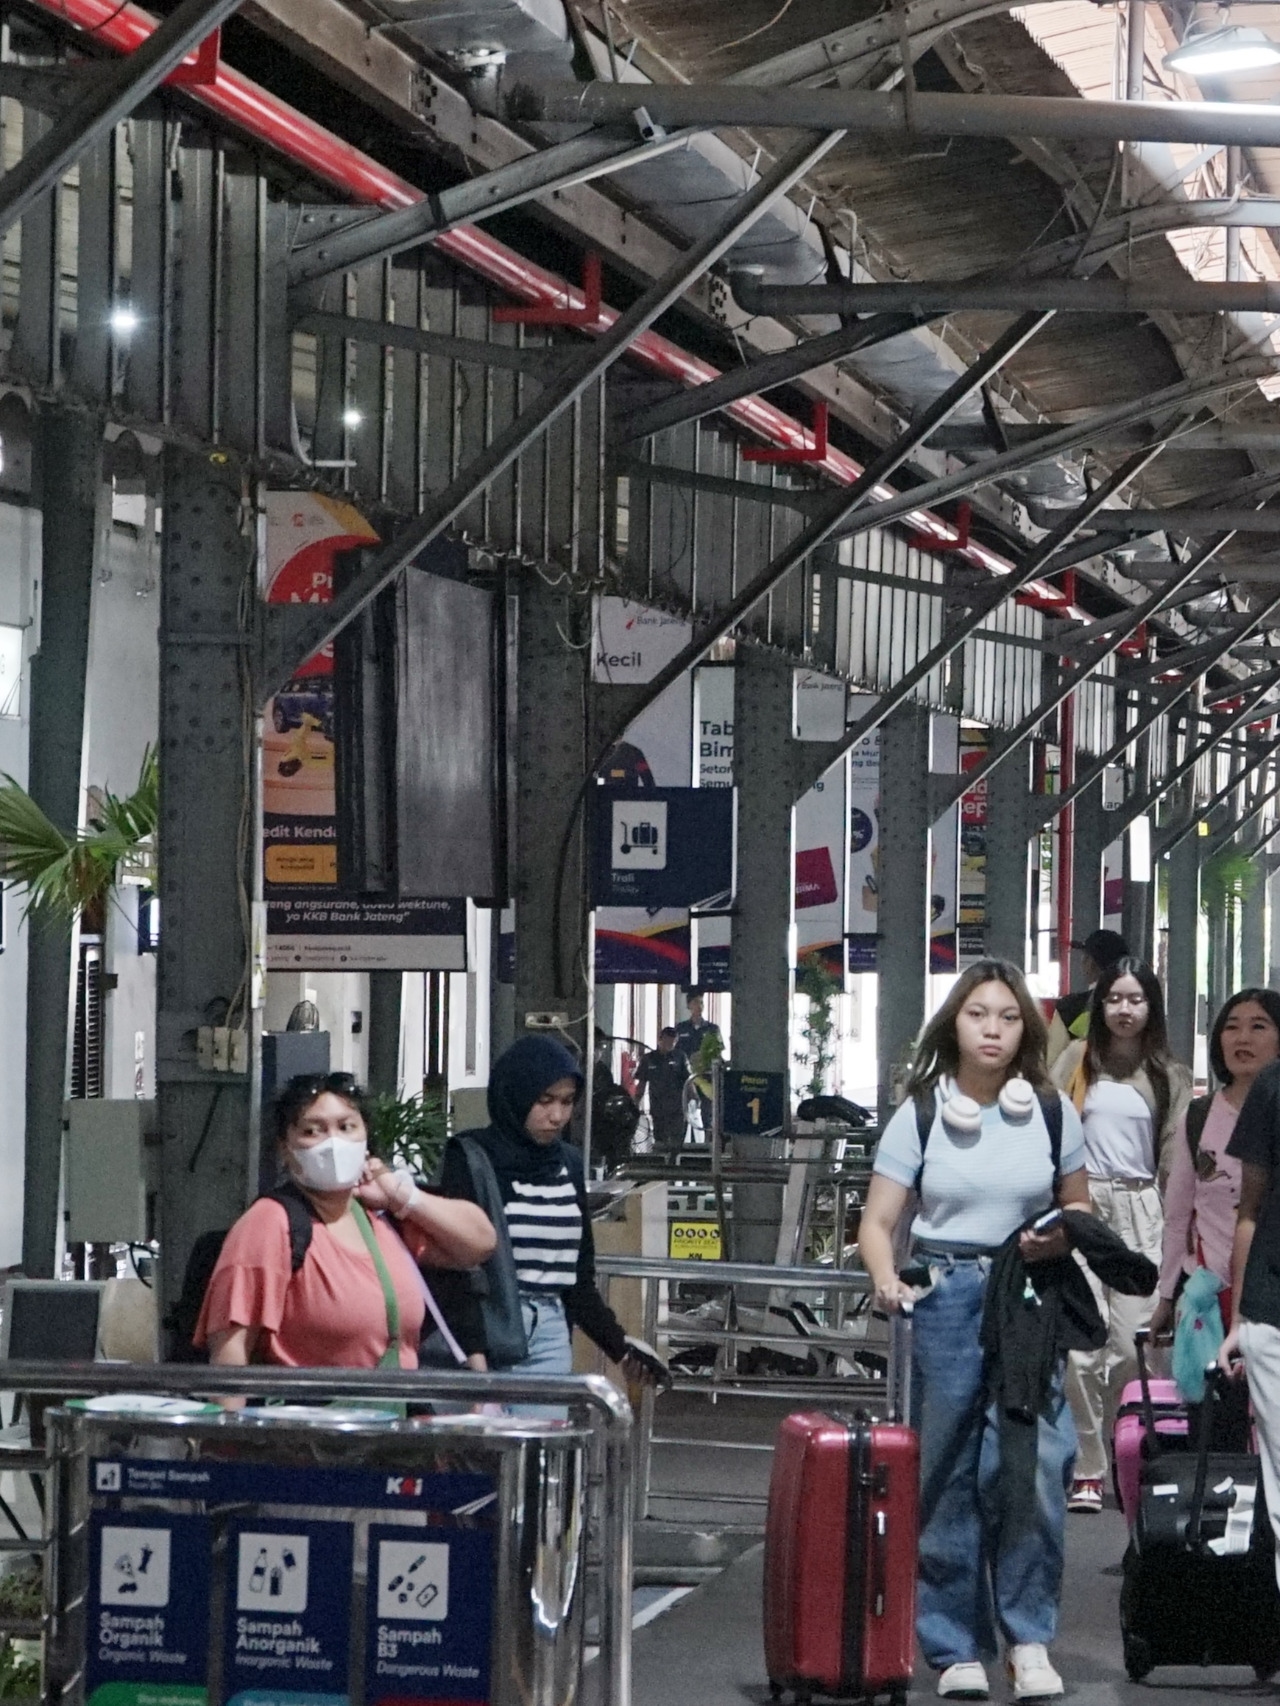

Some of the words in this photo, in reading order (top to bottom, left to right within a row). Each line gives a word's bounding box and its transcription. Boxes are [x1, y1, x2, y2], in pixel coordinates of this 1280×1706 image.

[597, 652, 642, 667] Kecil
[303, 912, 328, 921] KKB
[330, 911, 360, 921] Bank
[746, 1097, 760, 1125] 1
[168, 1469, 210, 1484] Sampah
[100, 1611, 165, 1632] Sampah
[236, 1616, 302, 1639] Sampah
[99, 1628, 163, 1649] Organik
[236, 1634, 320, 1655] Anorganik
[378, 1625, 442, 1647] Sampah
[99, 1646, 146, 1664] Organic
[149, 1650, 187, 1664] Waste
[378, 1642, 398, 1658] B3
[235, 1653, 291, 1670] Inorganic
[295, 1656, 333, 1671] Waste
[377, 1660, 439, 1678] Dangerous
[442, 1664, 480, 1679] Waste
